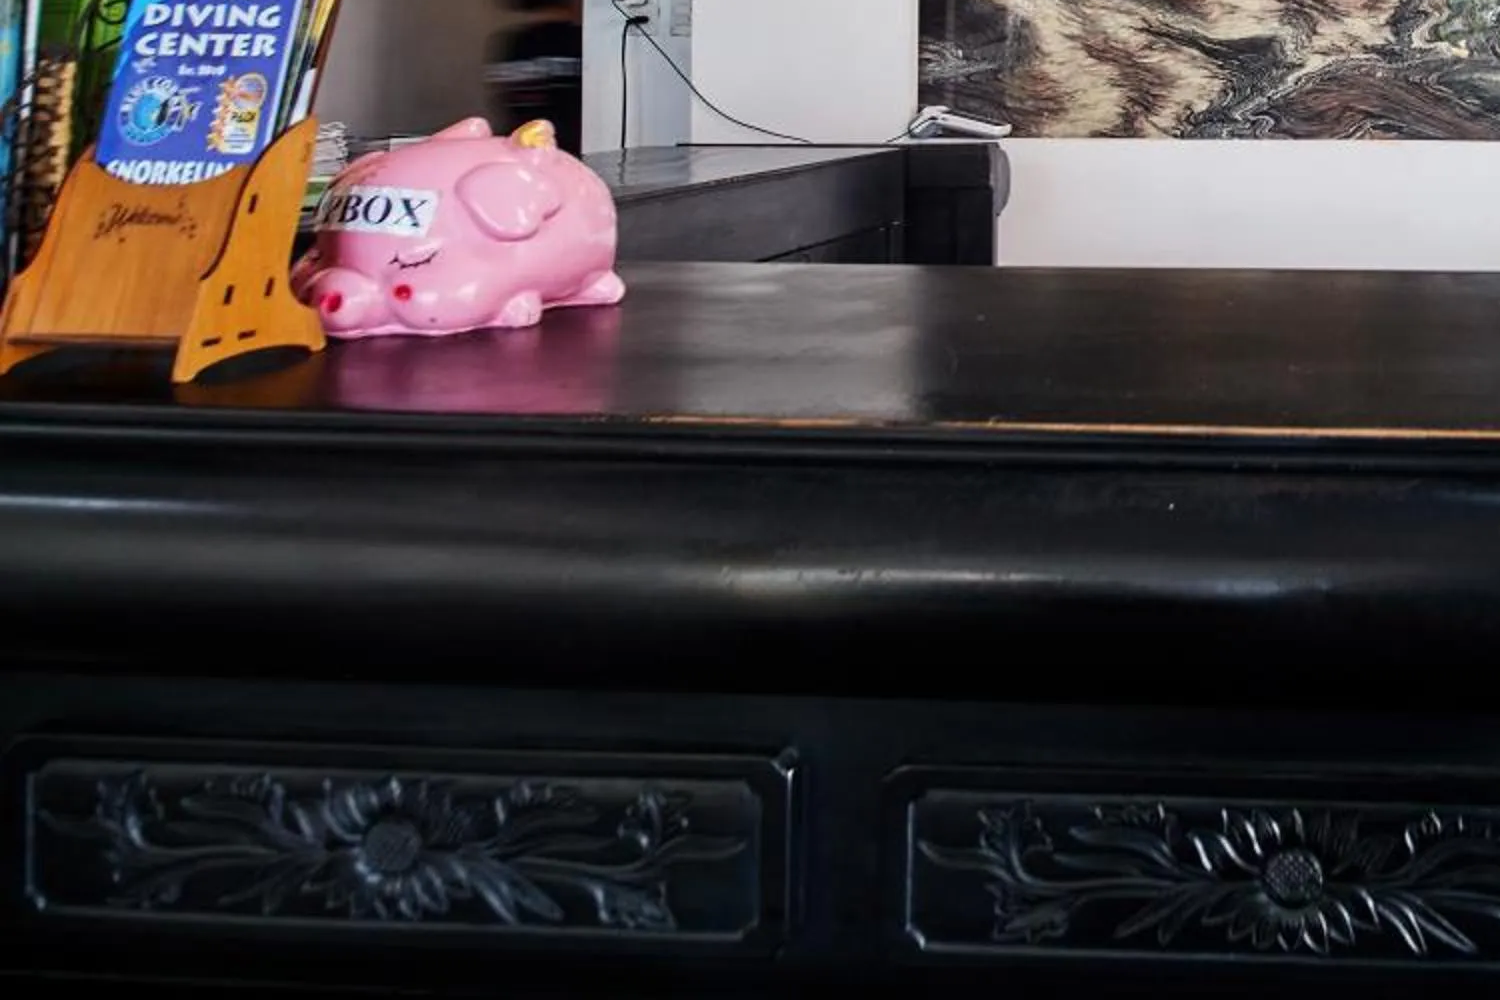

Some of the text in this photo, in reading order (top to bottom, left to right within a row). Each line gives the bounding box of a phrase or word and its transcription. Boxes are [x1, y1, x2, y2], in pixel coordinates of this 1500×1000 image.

[142, 3, 281, 29] DIVING
[134, 31, 278, 57] CENTER
[104, 159, 236, 185] SNORKELIN
